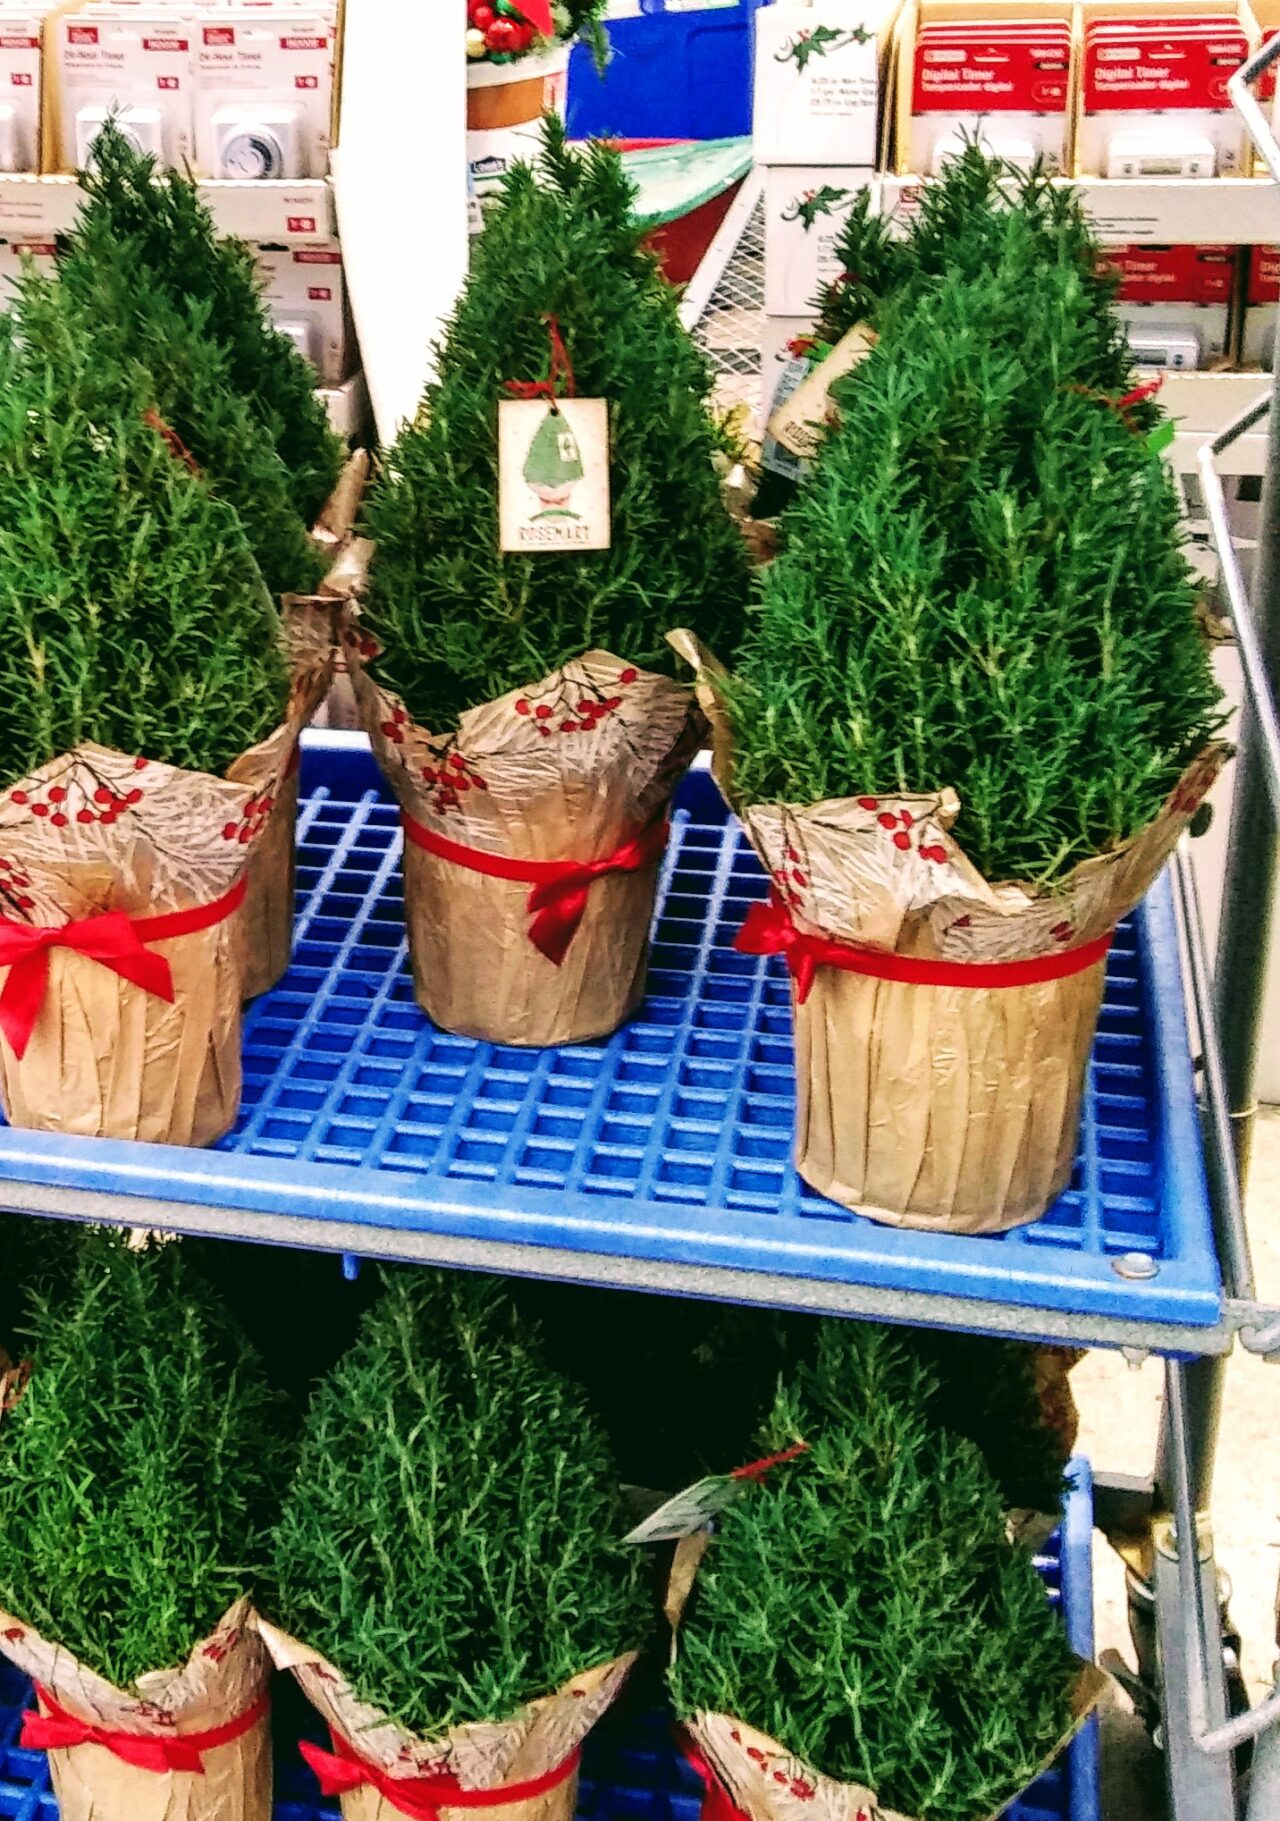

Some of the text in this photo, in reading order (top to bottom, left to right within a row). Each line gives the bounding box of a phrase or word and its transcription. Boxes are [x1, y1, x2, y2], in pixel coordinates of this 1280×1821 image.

[922, 67, 995, 82] Digital Timer
[1095, 65, 1170, 80] Digital Timer
